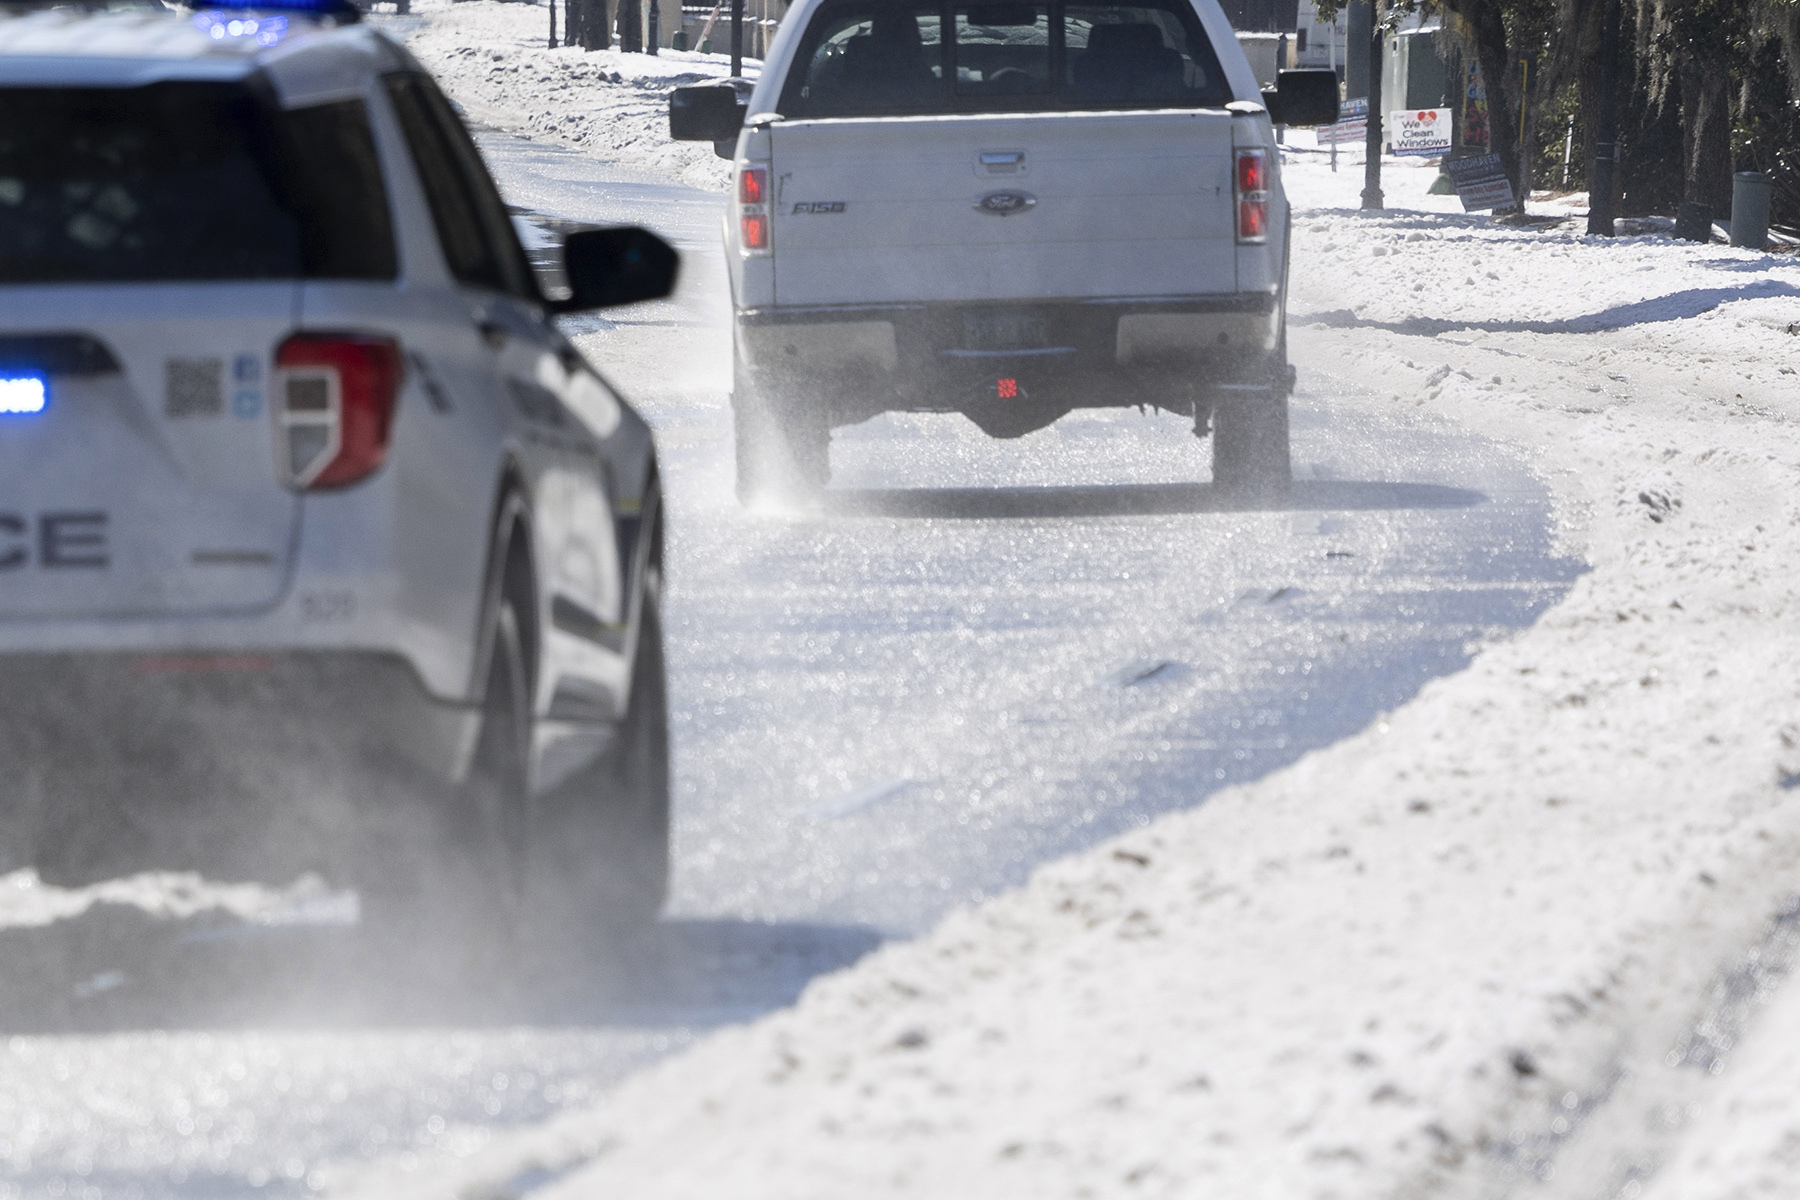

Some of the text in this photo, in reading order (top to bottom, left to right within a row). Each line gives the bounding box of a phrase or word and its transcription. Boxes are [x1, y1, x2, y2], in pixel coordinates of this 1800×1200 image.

[1402, 120, 1420, 128] We
[1403, 130, 1434, 138] Clean
[1397, 138, 1448, 147] Windows
[1446, 153, 1501, 171] WOODHAVEN
